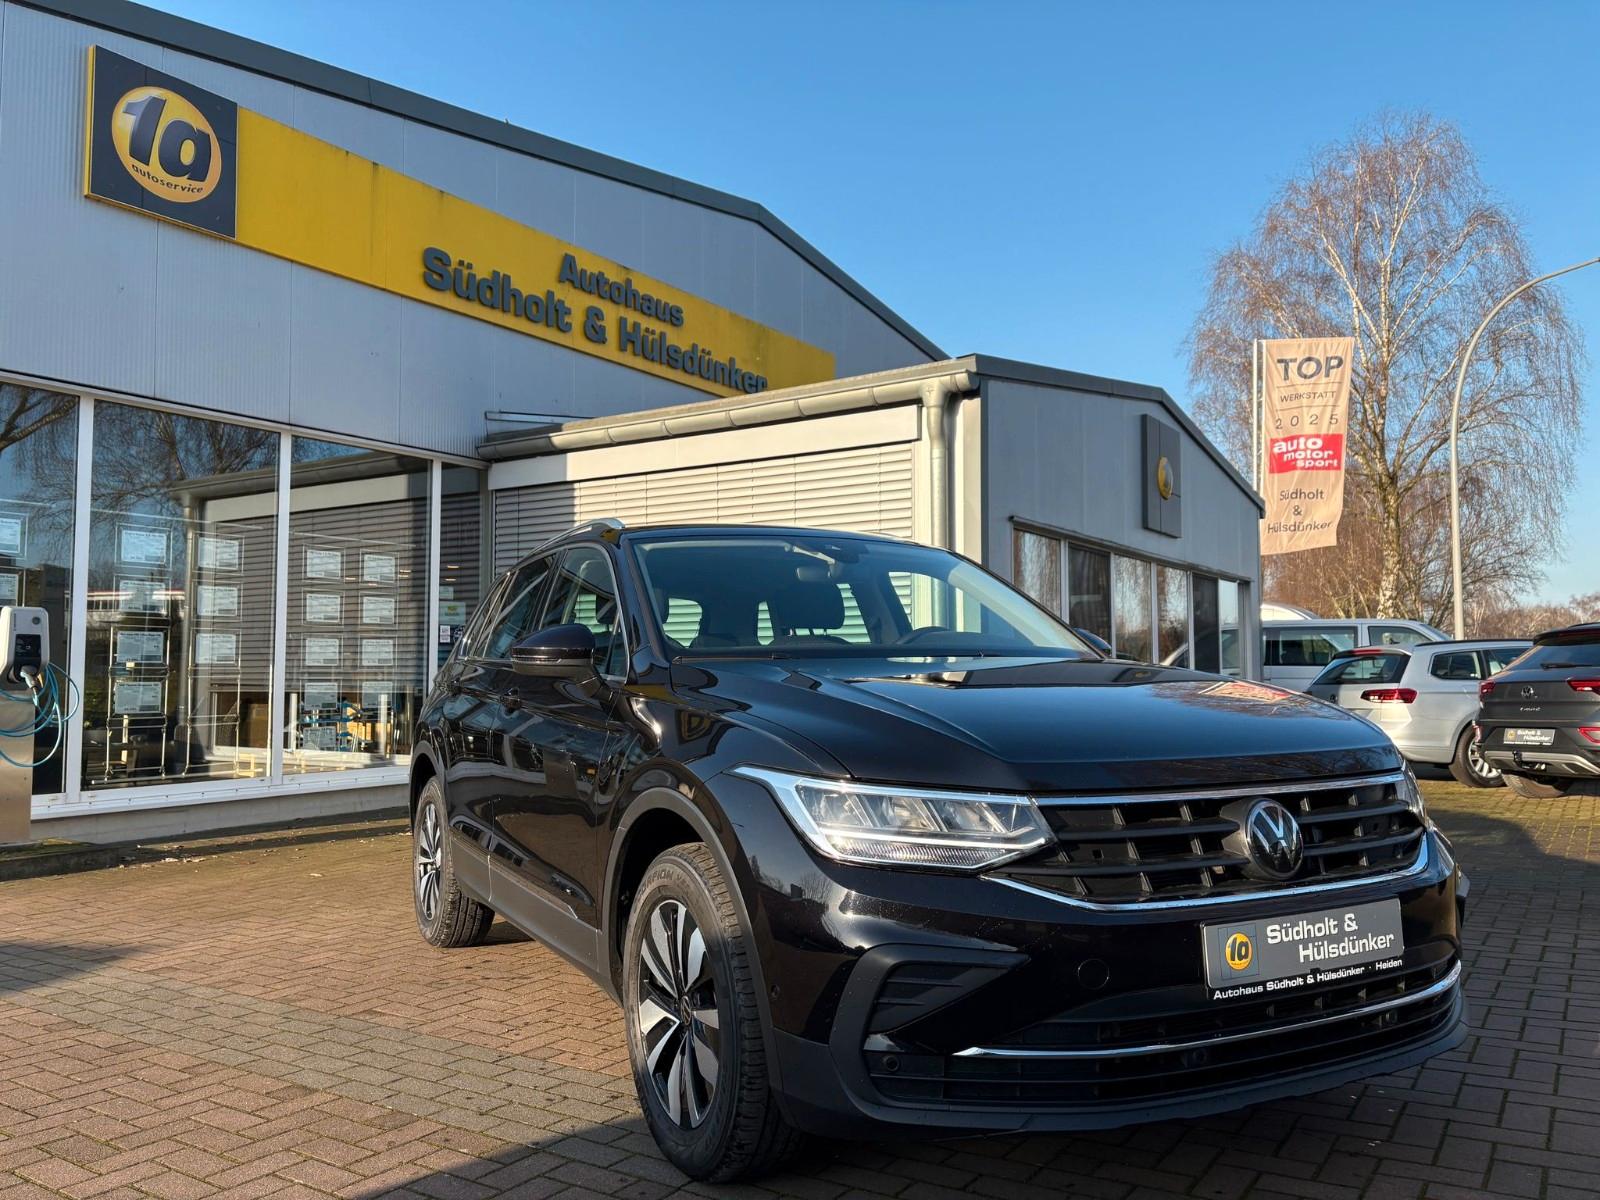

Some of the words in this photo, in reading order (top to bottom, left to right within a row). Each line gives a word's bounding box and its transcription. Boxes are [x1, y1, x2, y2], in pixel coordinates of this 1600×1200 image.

[122, 95, 212, 183] 1a
[131, 163, 204, 195] autoservice
[422, 247, 572, 333] Südholt
[584, 305, 607, 344] &
[559, 253, 684, 327] Autohaus
[1276, 355, 1344, 382] TOP
[1280, 390, 1337, 403] WERKSTATT
[1273, 436, 1323, 454] auto
[1283, 449, 1334, 462] motor
[1295, 458, 1338, 468] sport
[1279, 488, 1325, 501] Südholt
[1293, 504, 1303, 517] &
[1267, 520, 1334, 535] Hülsdünker
[1266, 917, 1339, 945] Südholt
[1344, 913, 1359, 932] &
[1298, 932, 1395, 964] Hülsdünker
[1213, 984, 1264, 1000] Autohaus
[1266, 977, 1304, 991] Südholt
[1306, 975, 1315, 984] &
[1316, 966, 1365, 982] Hülsdünker
[1375, 958, 1403, 970] Heiden
